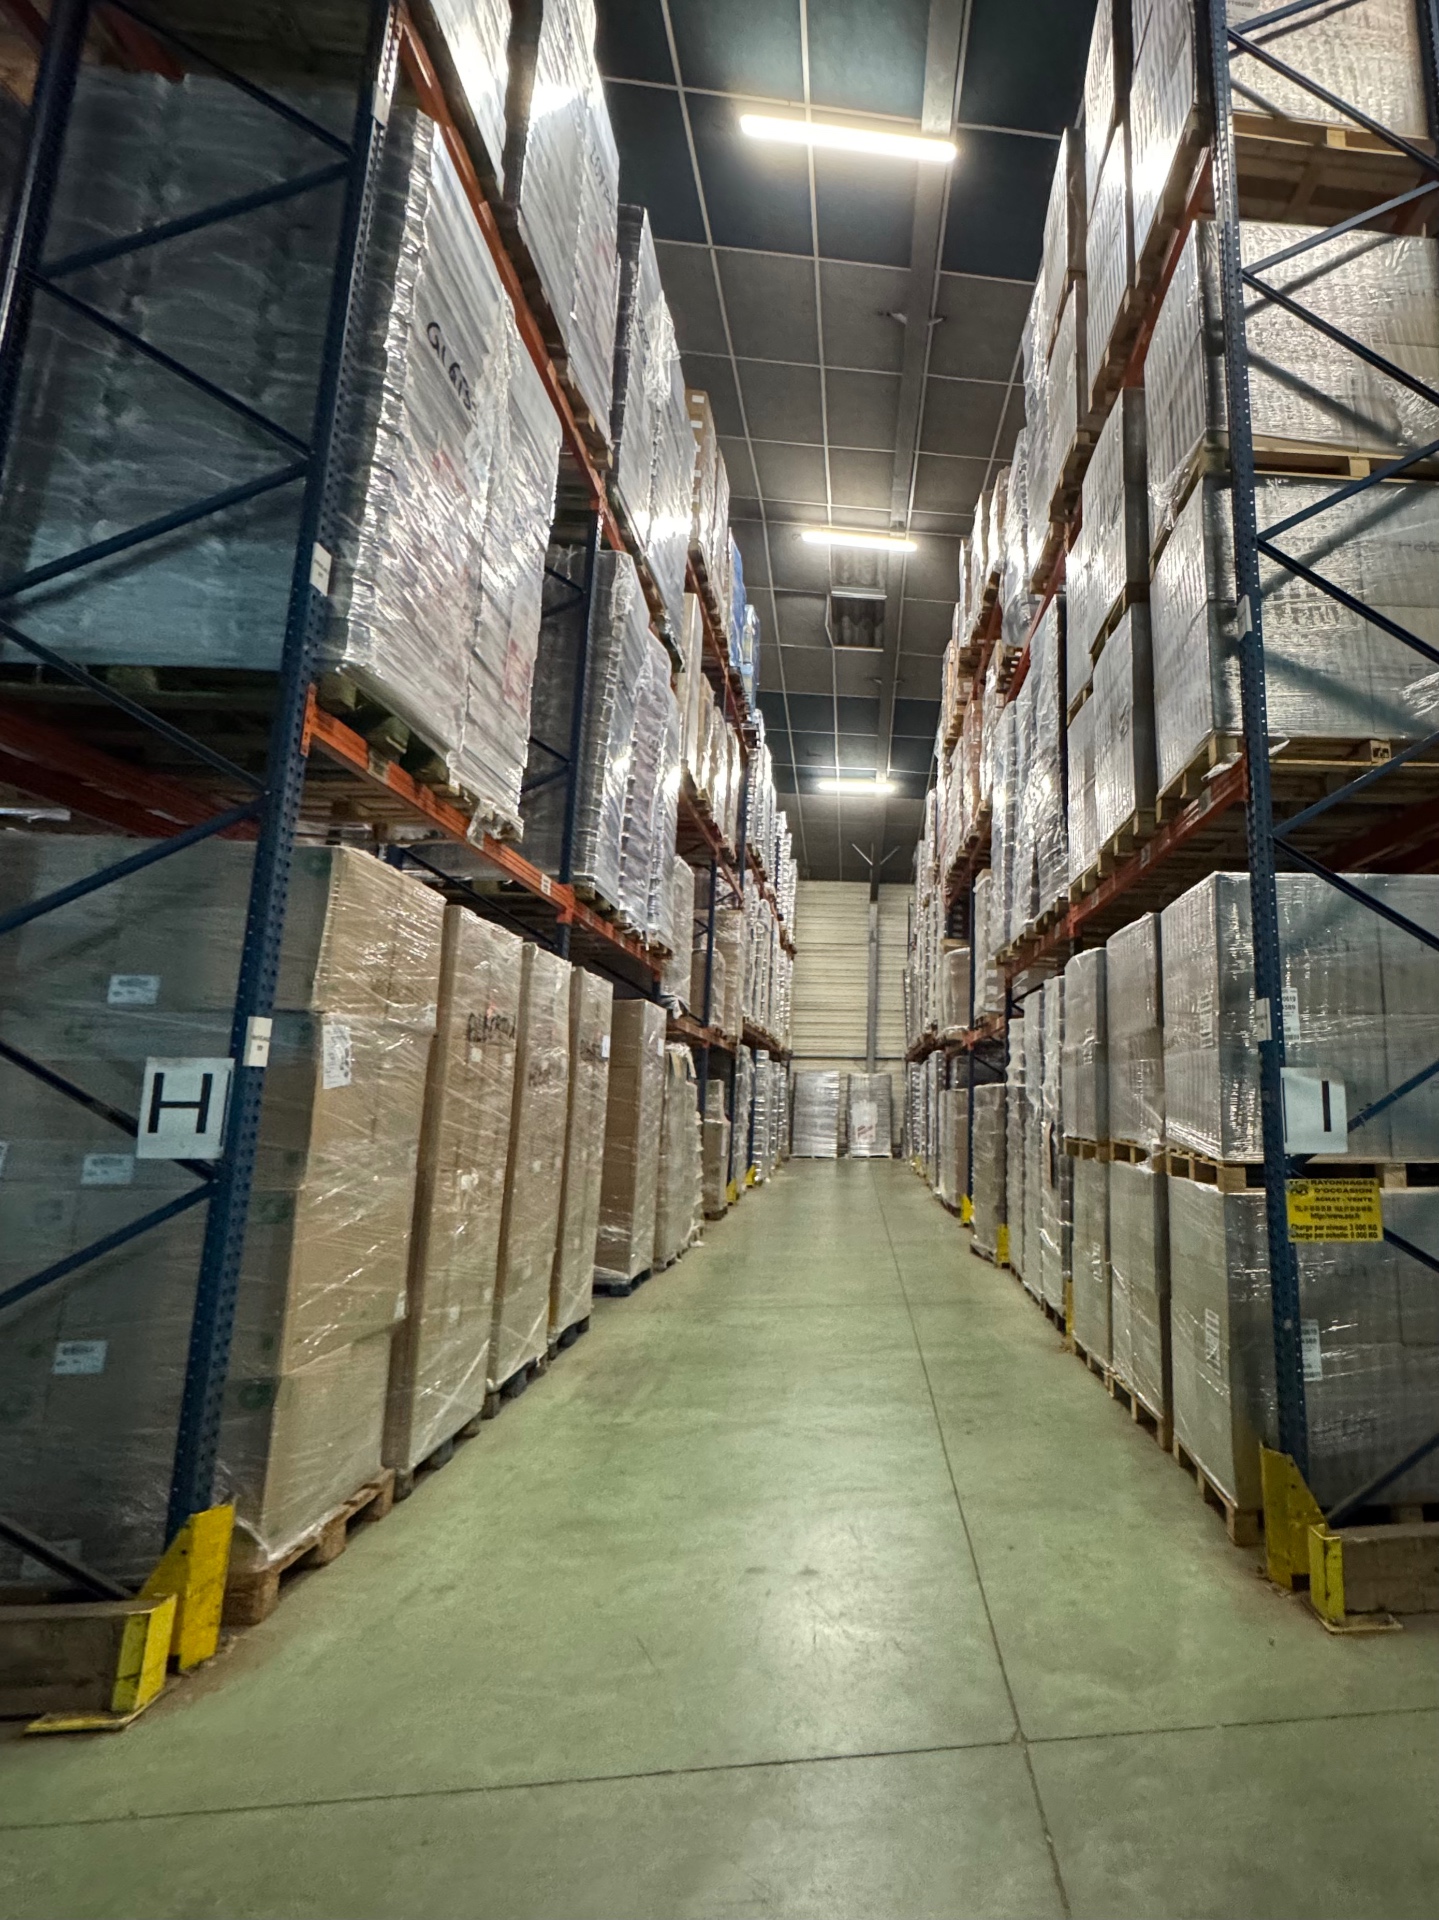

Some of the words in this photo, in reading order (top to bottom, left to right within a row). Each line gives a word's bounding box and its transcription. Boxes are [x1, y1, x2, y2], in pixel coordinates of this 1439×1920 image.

[148, 1073, 213, 1133] H
[1322, 1081, 1332, 1132] I
[1291, 1223, 1313, 1232] Charge
